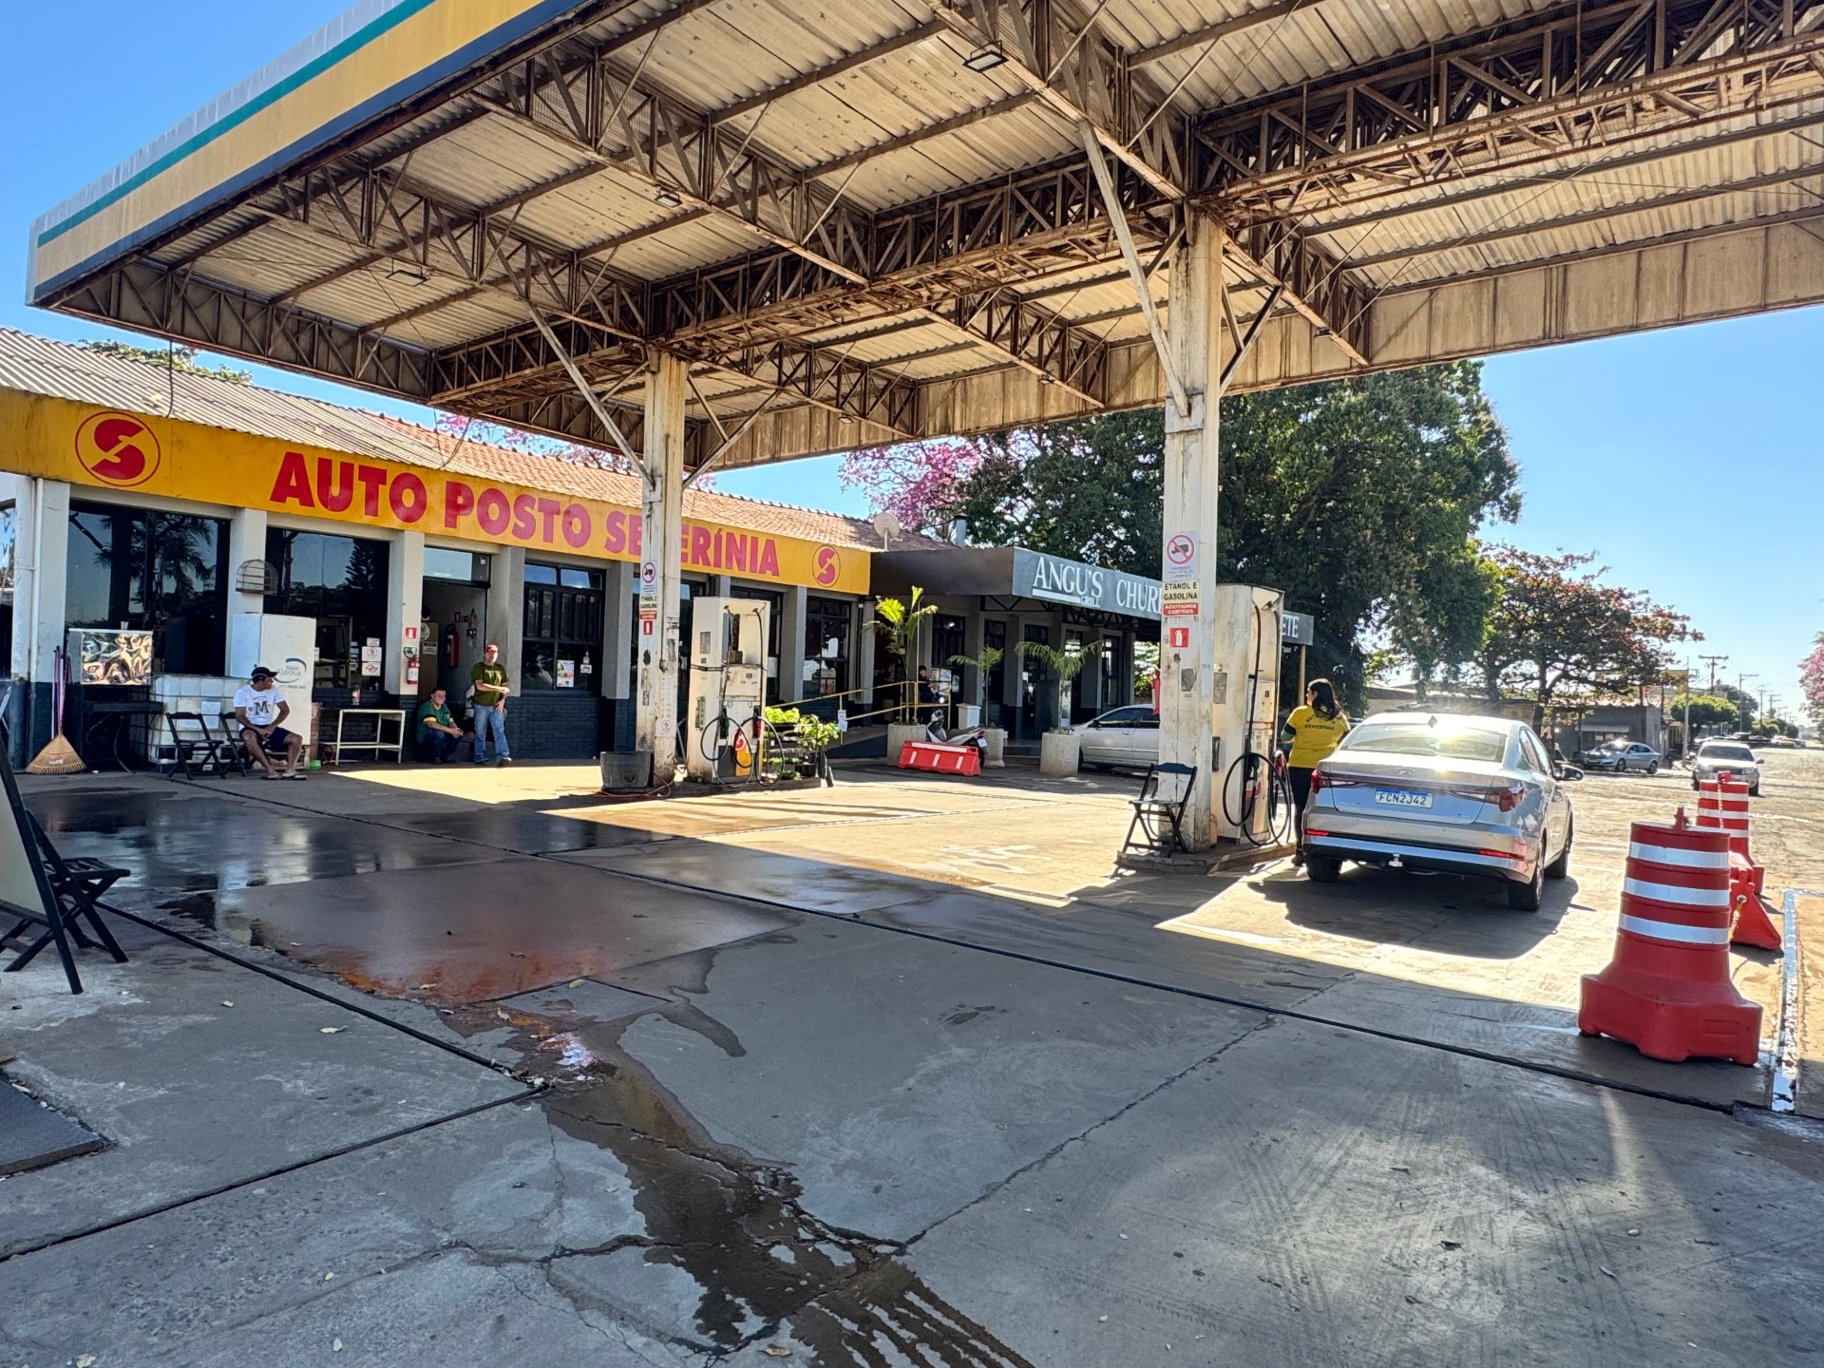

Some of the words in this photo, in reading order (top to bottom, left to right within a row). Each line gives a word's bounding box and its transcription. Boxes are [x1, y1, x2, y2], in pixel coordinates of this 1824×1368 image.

[269, 451, 428, 524] AUTO
[444, 480, 592, 549] POSTO
[604, 510, 780, 577] SEERÍNIA
[1164, 582, 1191, 591] ETANOL
[1193, 582, 1198, 590] E
[1032, 556, 1104, 598] ANGU'S
[1282, 614, 1300, 638] ETE
[1081, 596, 1101, 608] GRILL
[1163, 592, 1198, 601] GASOLINA
[1379, 792, 1427, 806] FCN2J42
